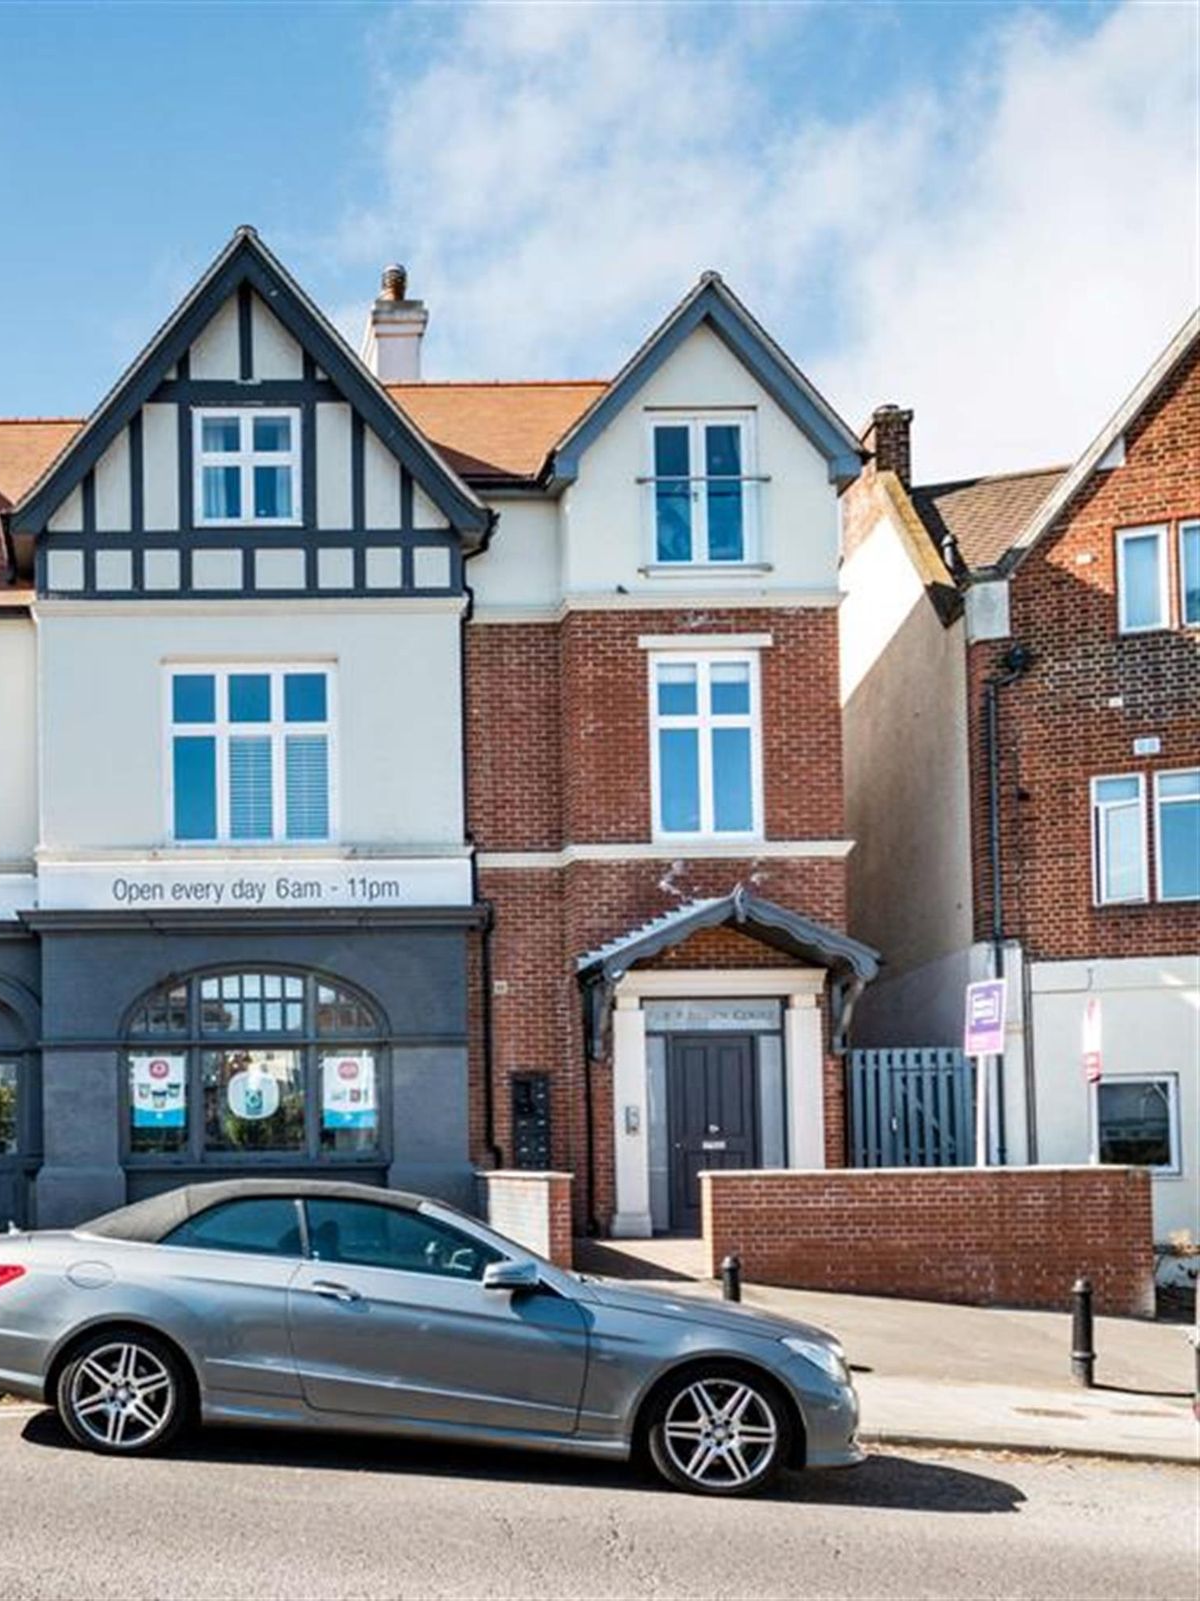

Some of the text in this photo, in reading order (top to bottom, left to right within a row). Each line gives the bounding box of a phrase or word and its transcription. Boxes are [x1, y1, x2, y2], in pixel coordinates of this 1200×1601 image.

[112, 878, 165, 905] Open
[171, 882, 225, 904] every
[231, 879, 266, 903] day
[276, 878, 322, 899] 6am
[347, 878, 400, 900] 11pm
